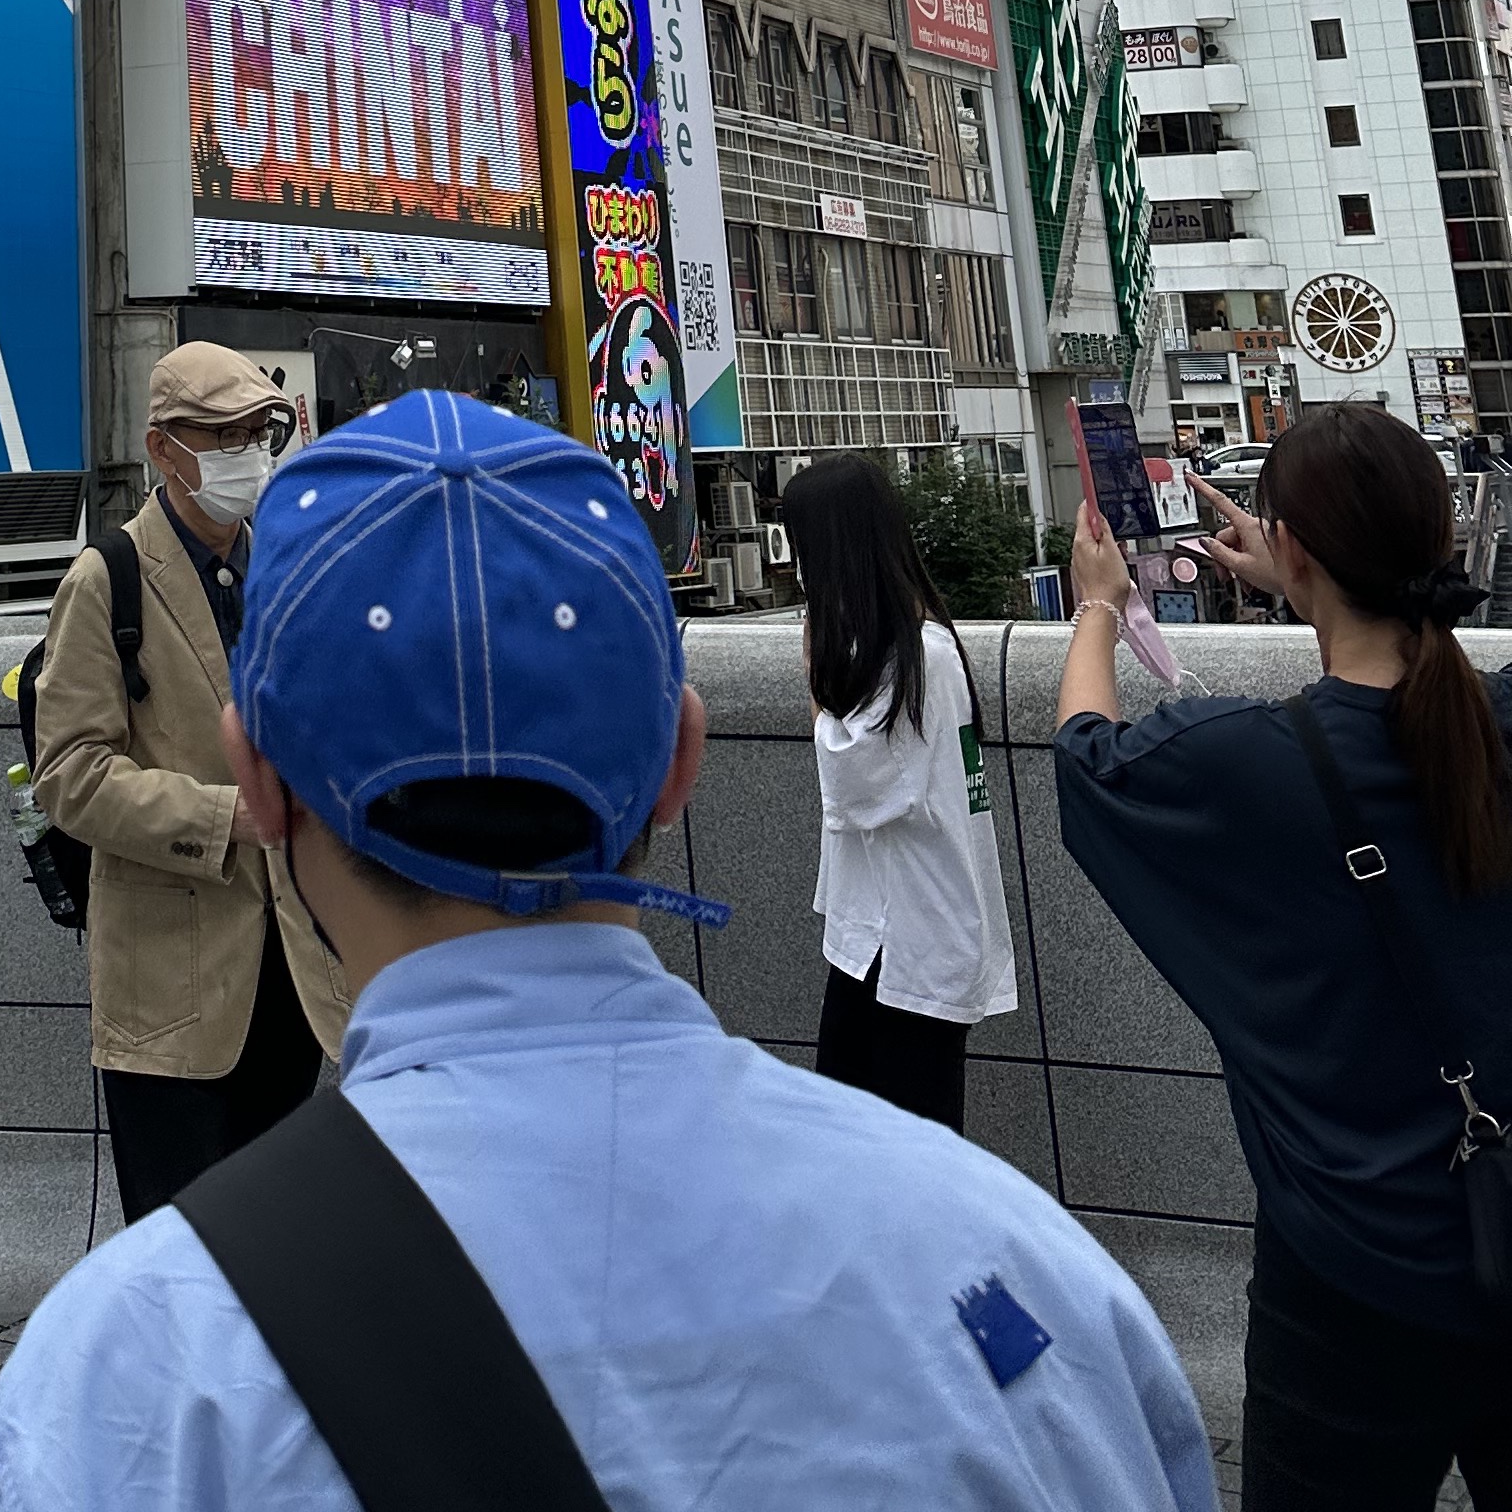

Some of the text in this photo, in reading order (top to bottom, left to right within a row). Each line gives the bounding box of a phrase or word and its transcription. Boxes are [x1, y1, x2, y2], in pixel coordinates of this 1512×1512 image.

[1125, 32, 1173, 45] もみ ほぐし
[1126, 49, 1148, 64] 28
[588, 193, 656, 240] ひまわり
[1152, 214, 1201, 229] UARD
[1295, 276, 1388, 317] FRUITS TOWER
